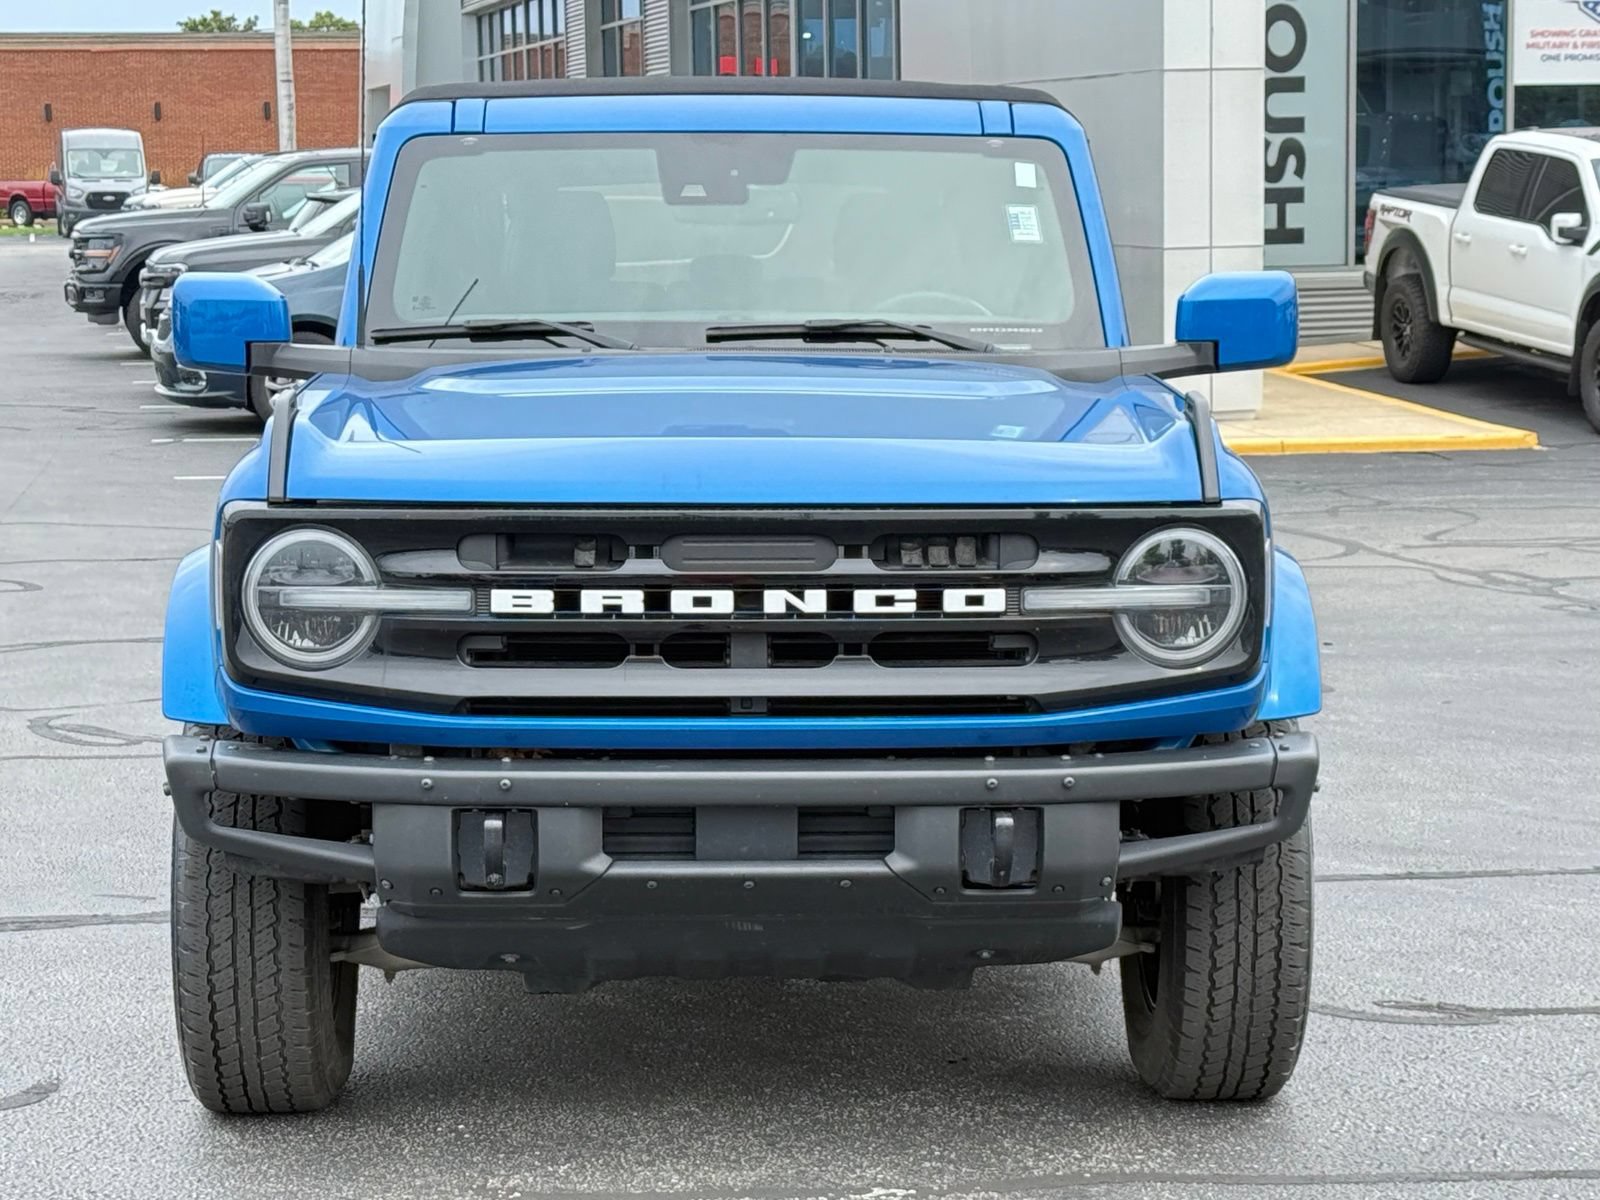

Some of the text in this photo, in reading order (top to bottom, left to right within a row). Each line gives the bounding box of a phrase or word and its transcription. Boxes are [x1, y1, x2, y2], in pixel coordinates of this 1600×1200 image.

[1526, 41, 1570, 50] MILITARY
[1540, 53, 1561, 62] ONE
[1264, 1, 1307, 245] OUSH
[490, 588, 1006, 615] BRONCO
